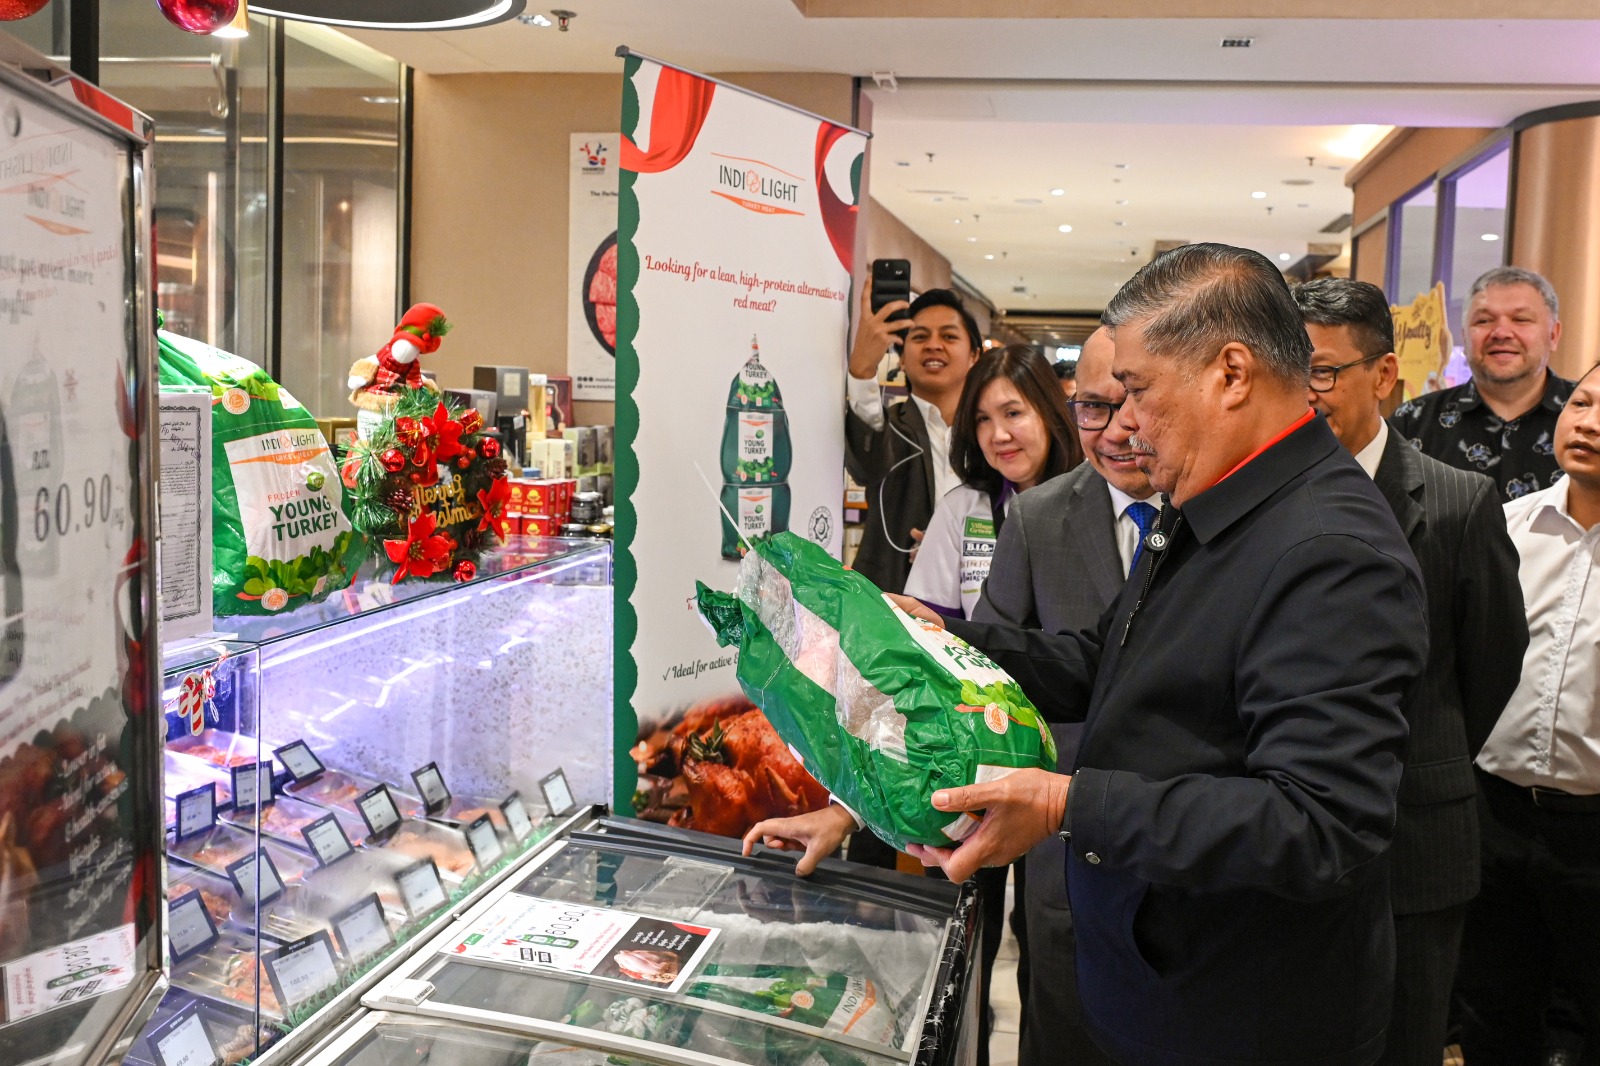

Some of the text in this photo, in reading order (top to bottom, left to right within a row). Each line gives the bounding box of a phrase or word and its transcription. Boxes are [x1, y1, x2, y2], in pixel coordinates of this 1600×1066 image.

[742, 200, 760, 209] TURKEY
[646, 255, 845, 301] Looking for a lean, high-protein alternative to
[733, 295, 777, 312] red meat?
[34, 473, 111, 542] 60.90
[268, 490, 300, 502] FROZEN
[269, 495, 331, 522] YOUNG
[272, 511, 337, 541] TURKEY
[744, 522, 765, 530] TURKEY
[672, 661, 694, 679] Ideal
[695, 659, 707, 679] for
[709, 656, 732, 670] active
